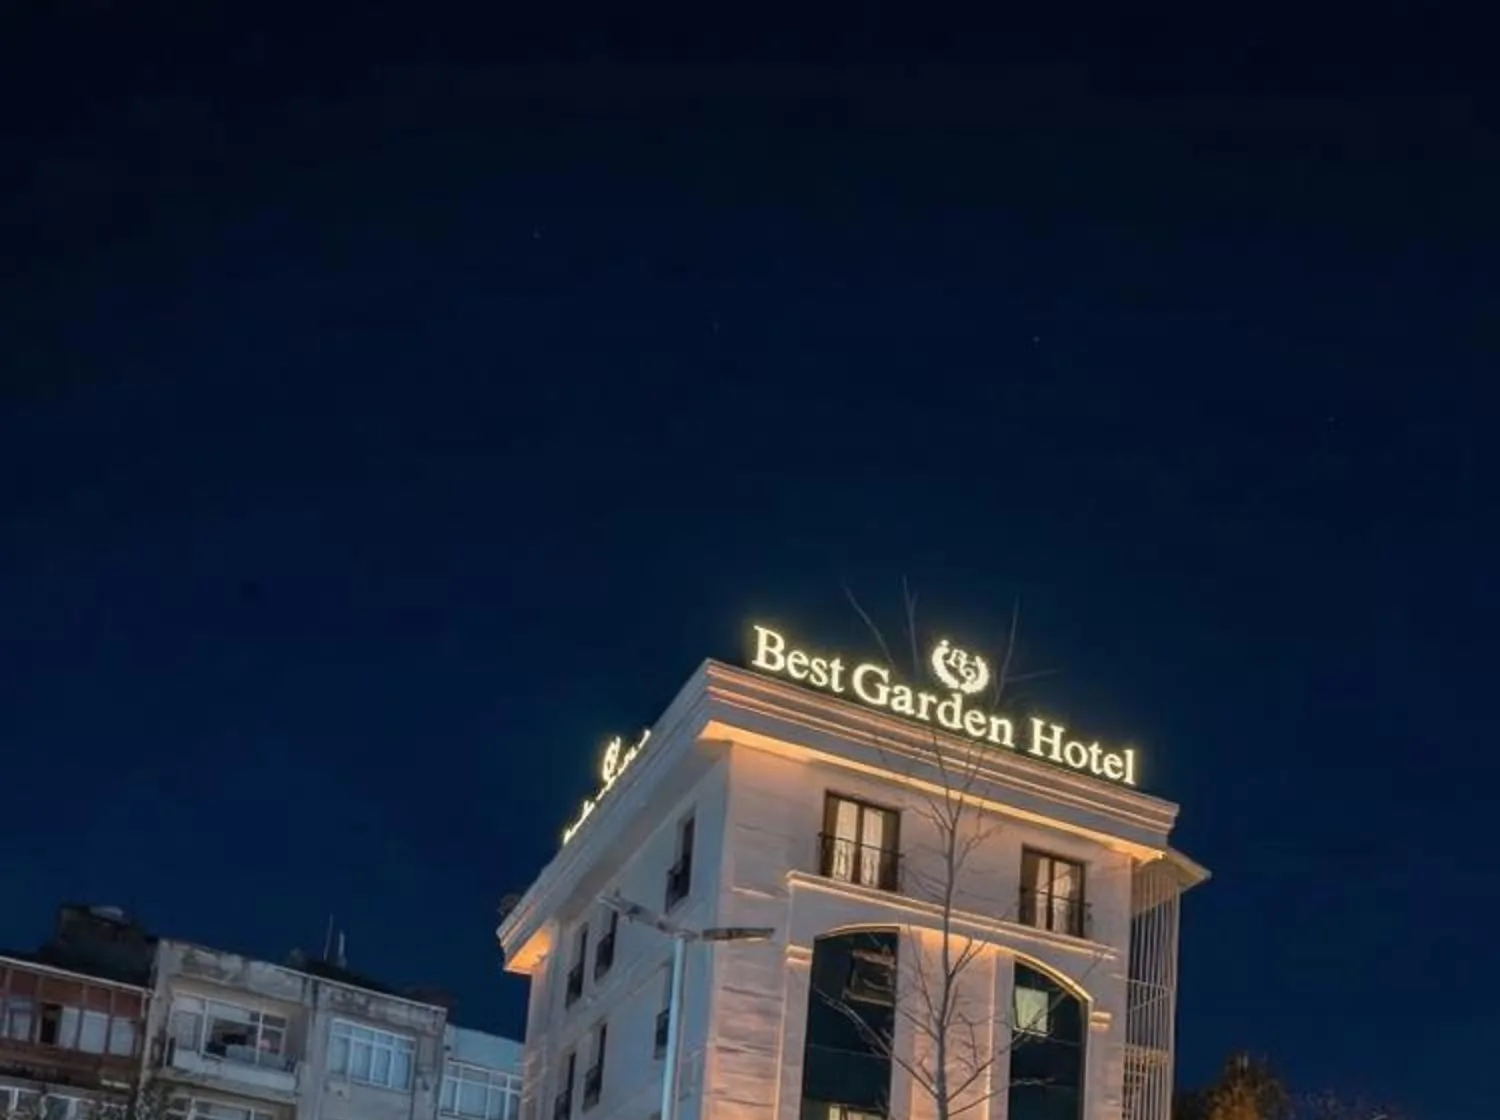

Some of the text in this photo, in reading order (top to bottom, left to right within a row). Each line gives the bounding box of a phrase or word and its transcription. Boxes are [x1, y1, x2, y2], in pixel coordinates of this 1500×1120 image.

[752, 625, 1136, 785] Best Garden Hotel
